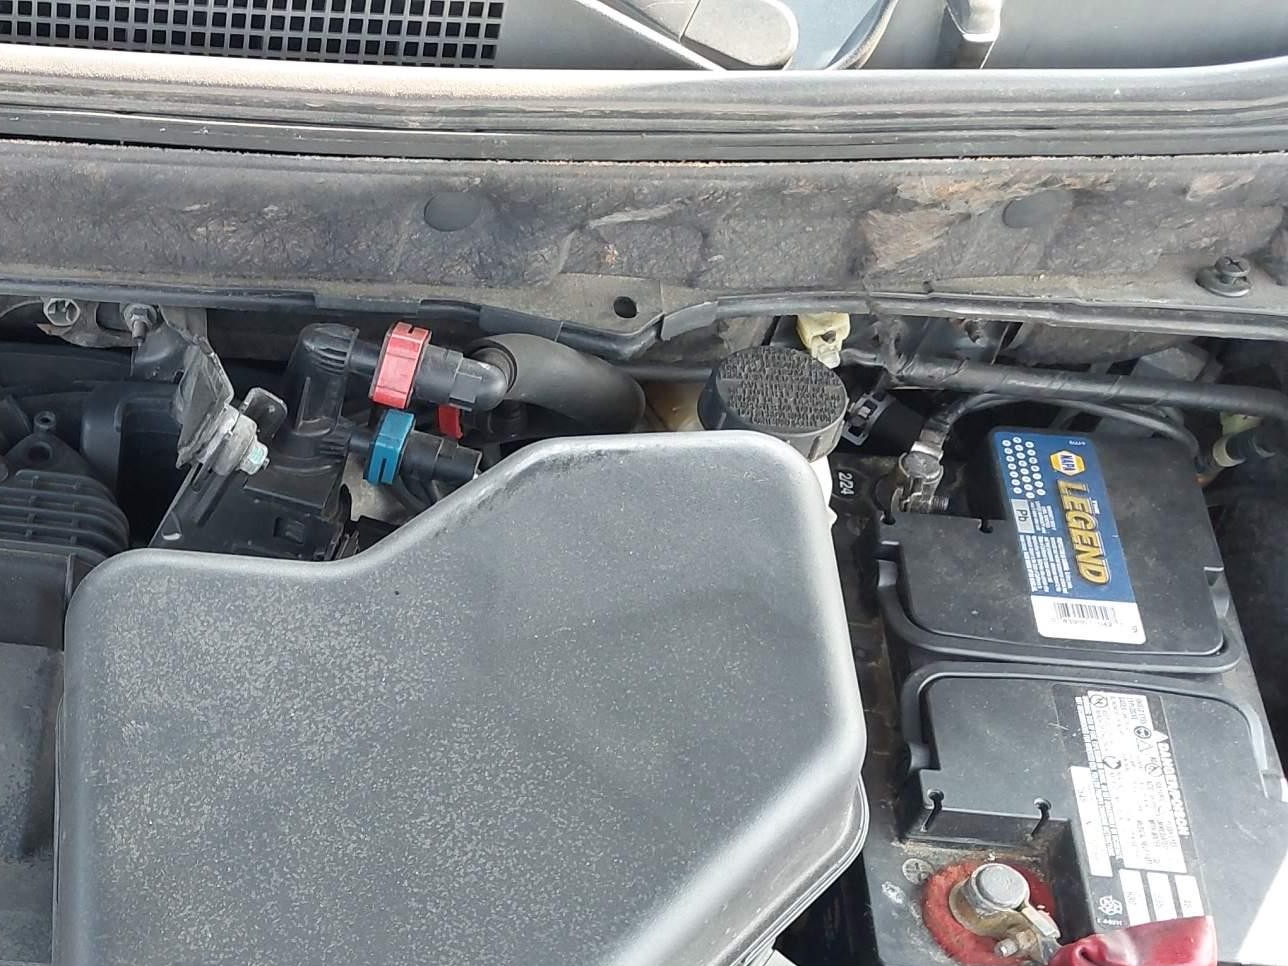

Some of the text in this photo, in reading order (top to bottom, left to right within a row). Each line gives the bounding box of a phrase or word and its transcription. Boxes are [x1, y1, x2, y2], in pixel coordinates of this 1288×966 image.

[838, 471, 855, 495] 2/24
[1015, 509, 1030, 522] Pb
[1057, 479, 1111, 585] LEGEND
